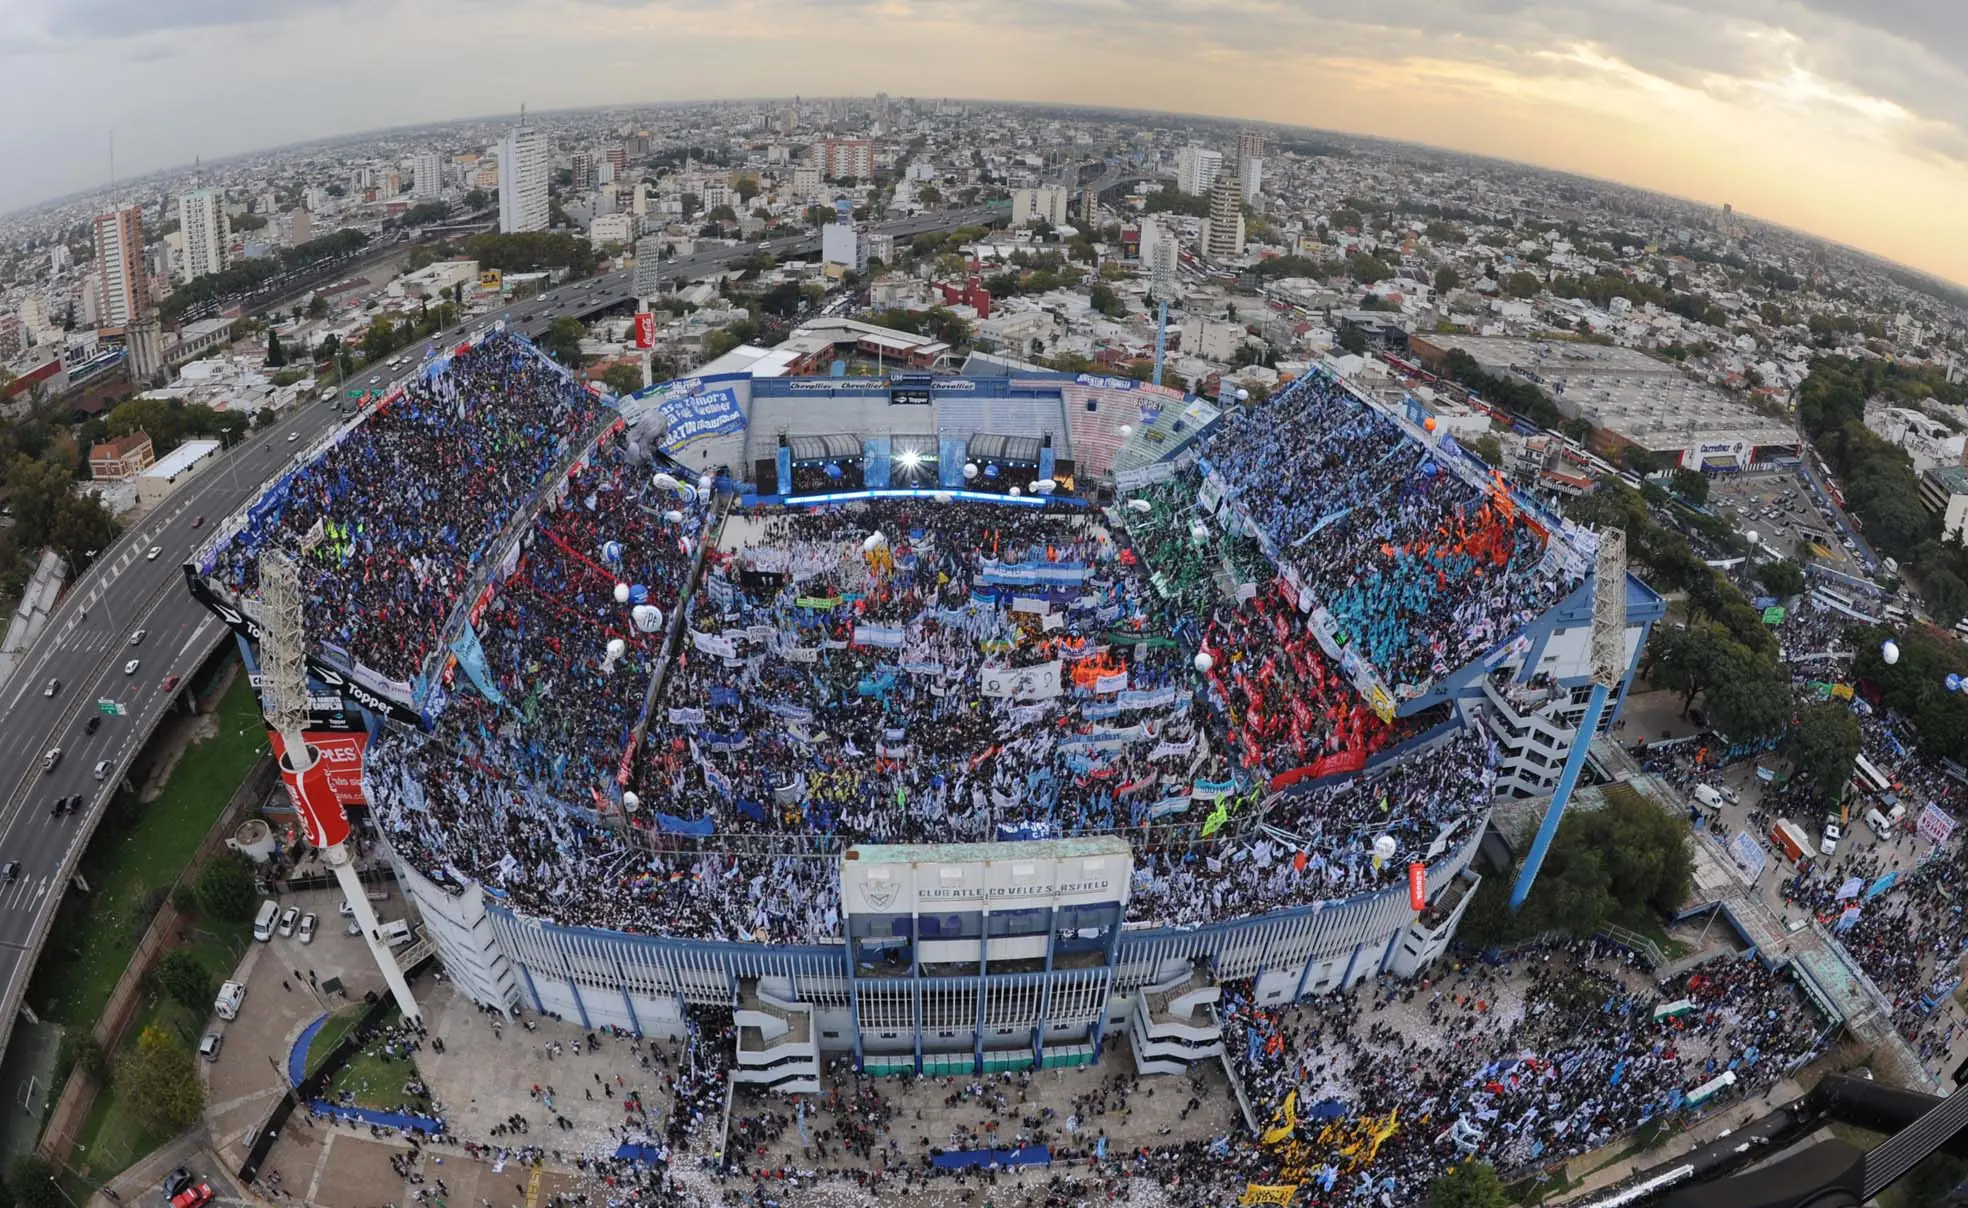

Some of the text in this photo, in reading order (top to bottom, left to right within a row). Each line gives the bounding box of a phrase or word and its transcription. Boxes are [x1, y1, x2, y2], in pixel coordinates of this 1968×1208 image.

[790, 382, 832, 390] Chevallier
[841, 382, 883, 390] Chevallier
[931, 382, 974, 390] Chevallier
[1700, 443, 1731, 453] Carrefour
[347, 682, 395, 715] Topper
[918, 889, 951, 897] CLUB
